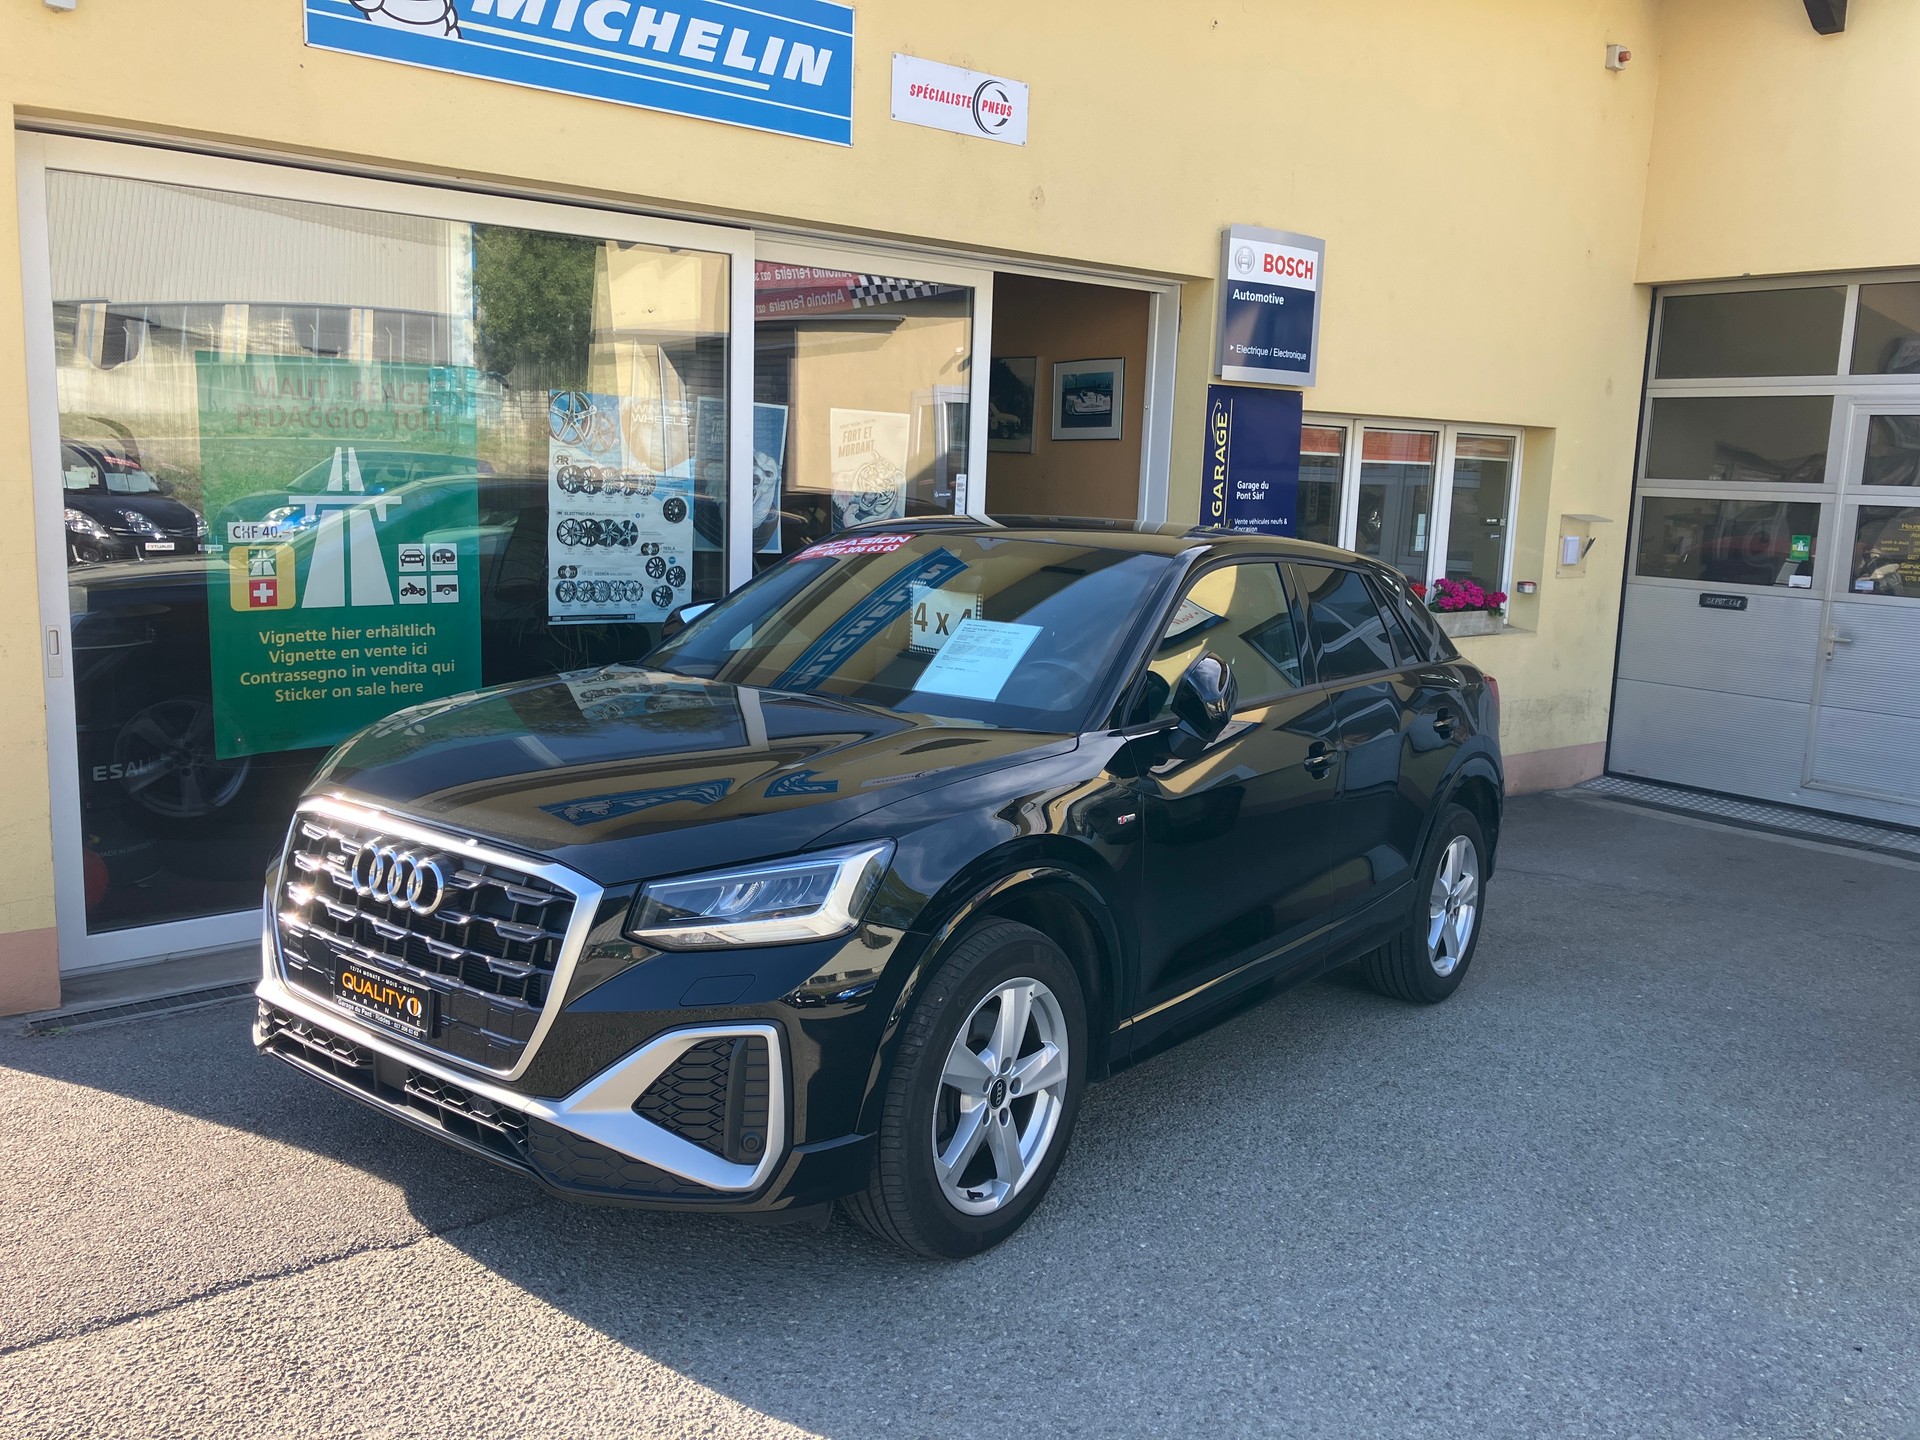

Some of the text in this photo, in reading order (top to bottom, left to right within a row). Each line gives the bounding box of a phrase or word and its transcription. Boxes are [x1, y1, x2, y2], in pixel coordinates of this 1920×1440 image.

[909, 83, 1013, 117] SPÉCIALISTE PNEUS
[1263, 253, 1314, 280] BOSCH
[1232, 288, 1285, 305] Automotive
[1236, 344, 1269, 357] Electrique
[1273, 348, 1307, 361] Electronique
[253, 375, 430, 405] MAUT PÉAGE
[236, 403, 445, 432] PEDAGGIO TOLL
[843, 426, 873, 443] FORT ET
[838, 440, 875, 458] MORDANT
[1211, 412, 1228, 517] GARAGE
[1236, 491, 1251, 500] Pont
[1237, 480, 1269, 491] Garage du
[232, 525, 258, 539] CHF
[913, 602, 928, 633] 4
[258, 623, 436, 647] Vignette hier erhältlich
[268, 642, 428, 666] Vignette en vente ici
[239, 659, 455, 686] Contrassegno in vendita qui
[274, 681, 424, 703] Sticker on sale here
[342, 972, 407, 1010] QUALITY
[385, 979, 398, 988] MOIS
